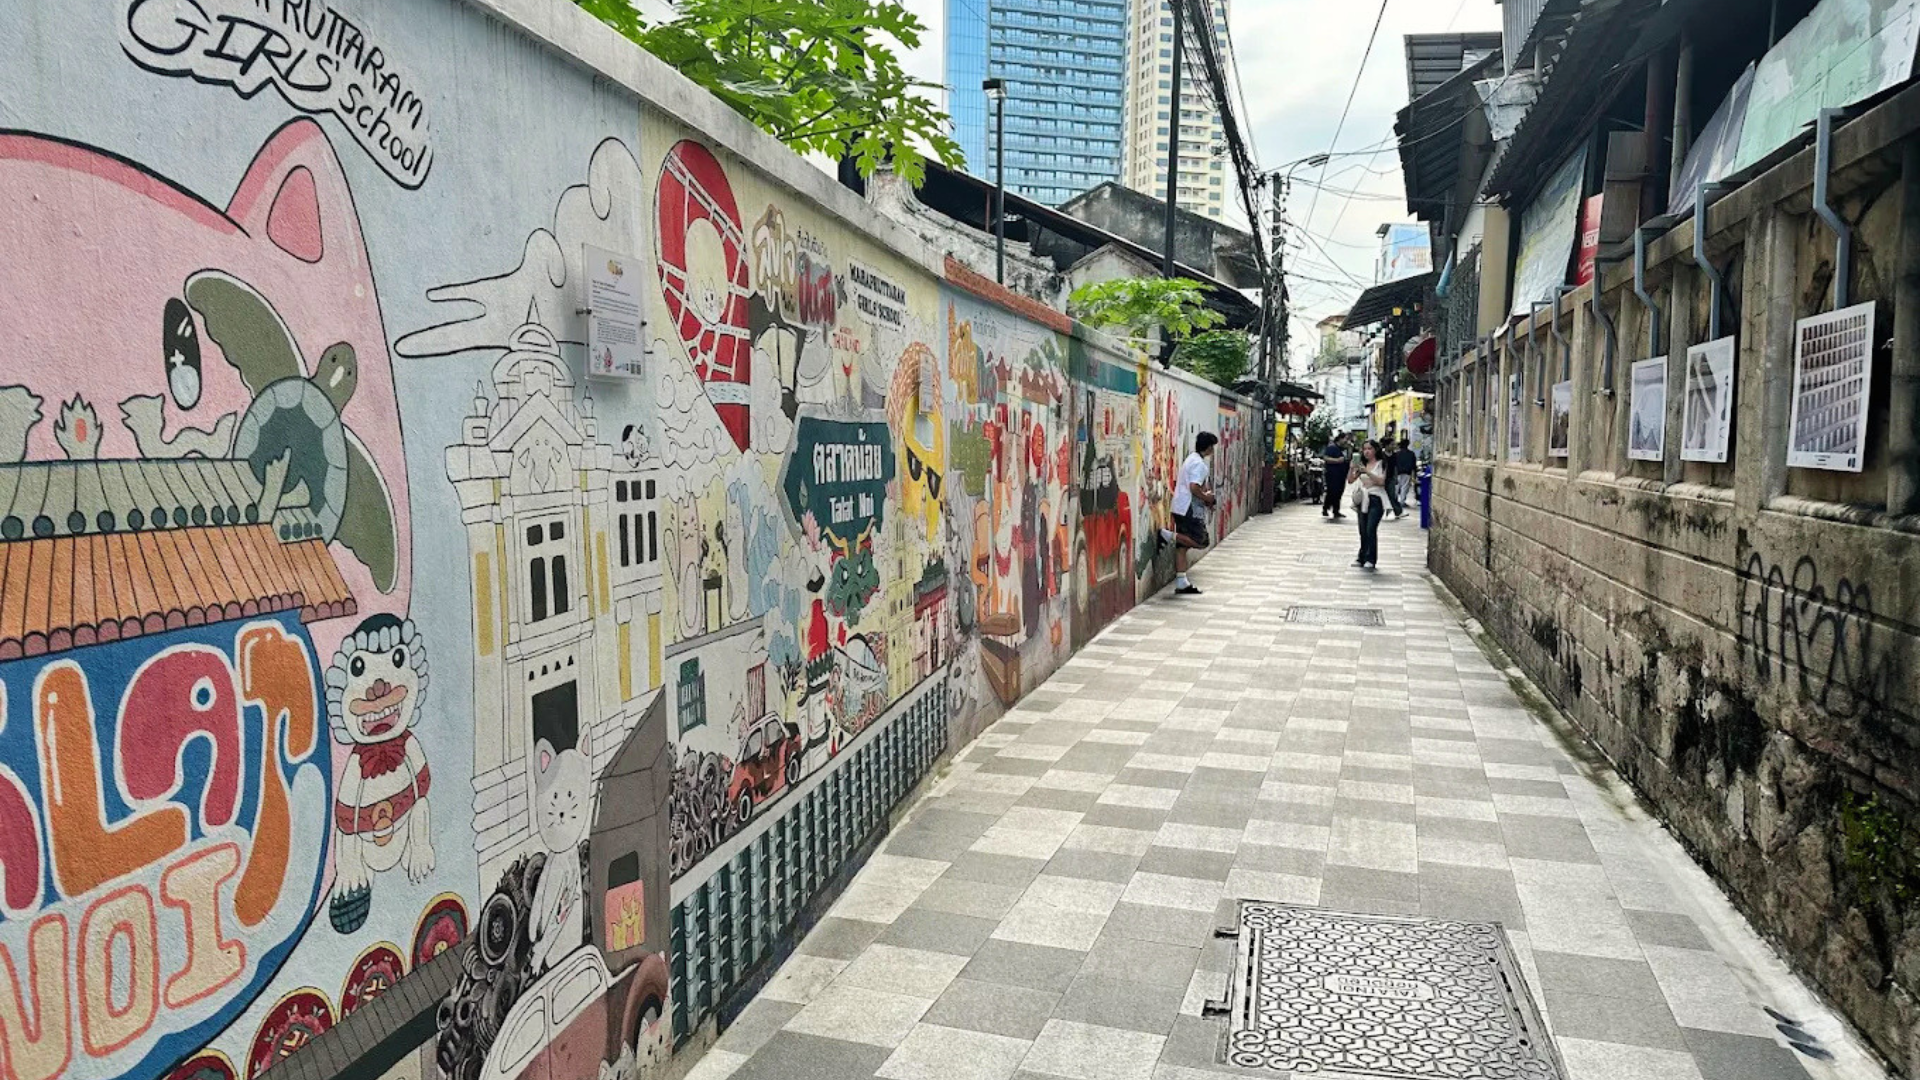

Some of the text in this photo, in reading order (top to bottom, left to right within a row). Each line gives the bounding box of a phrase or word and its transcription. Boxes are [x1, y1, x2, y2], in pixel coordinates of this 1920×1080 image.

[813, 428, 883, 485] ตลาดน้อย
[829, 492, 875, 523] Talat Noi
